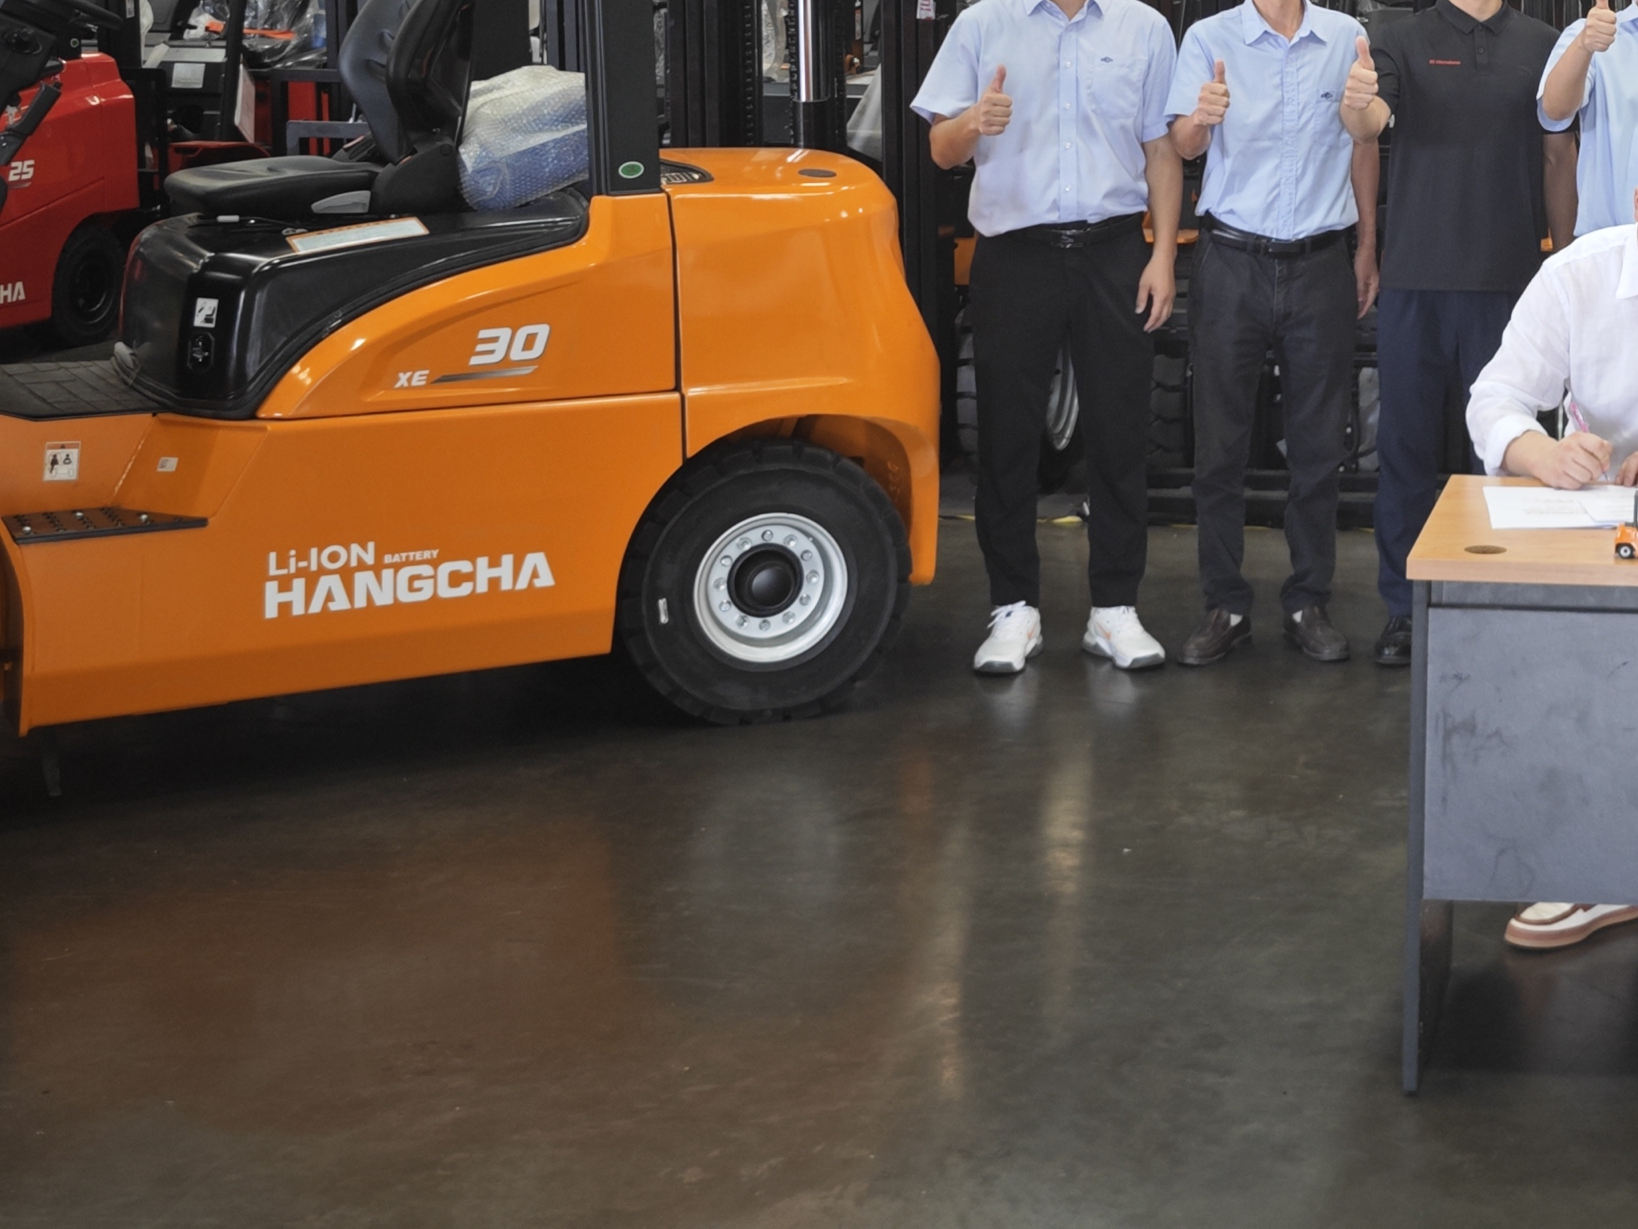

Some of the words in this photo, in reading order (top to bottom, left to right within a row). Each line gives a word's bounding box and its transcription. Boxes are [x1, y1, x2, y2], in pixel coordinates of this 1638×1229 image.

[8, 159, 35, 182] 25
[468, 323, 551, 367] 30
[393, 369, 431, 389] XE
[269, 540, 376, 576] Li-ION
[384, 548, 440, 564] BATTERY
[264, 551, 556, 619] HANGCHA
